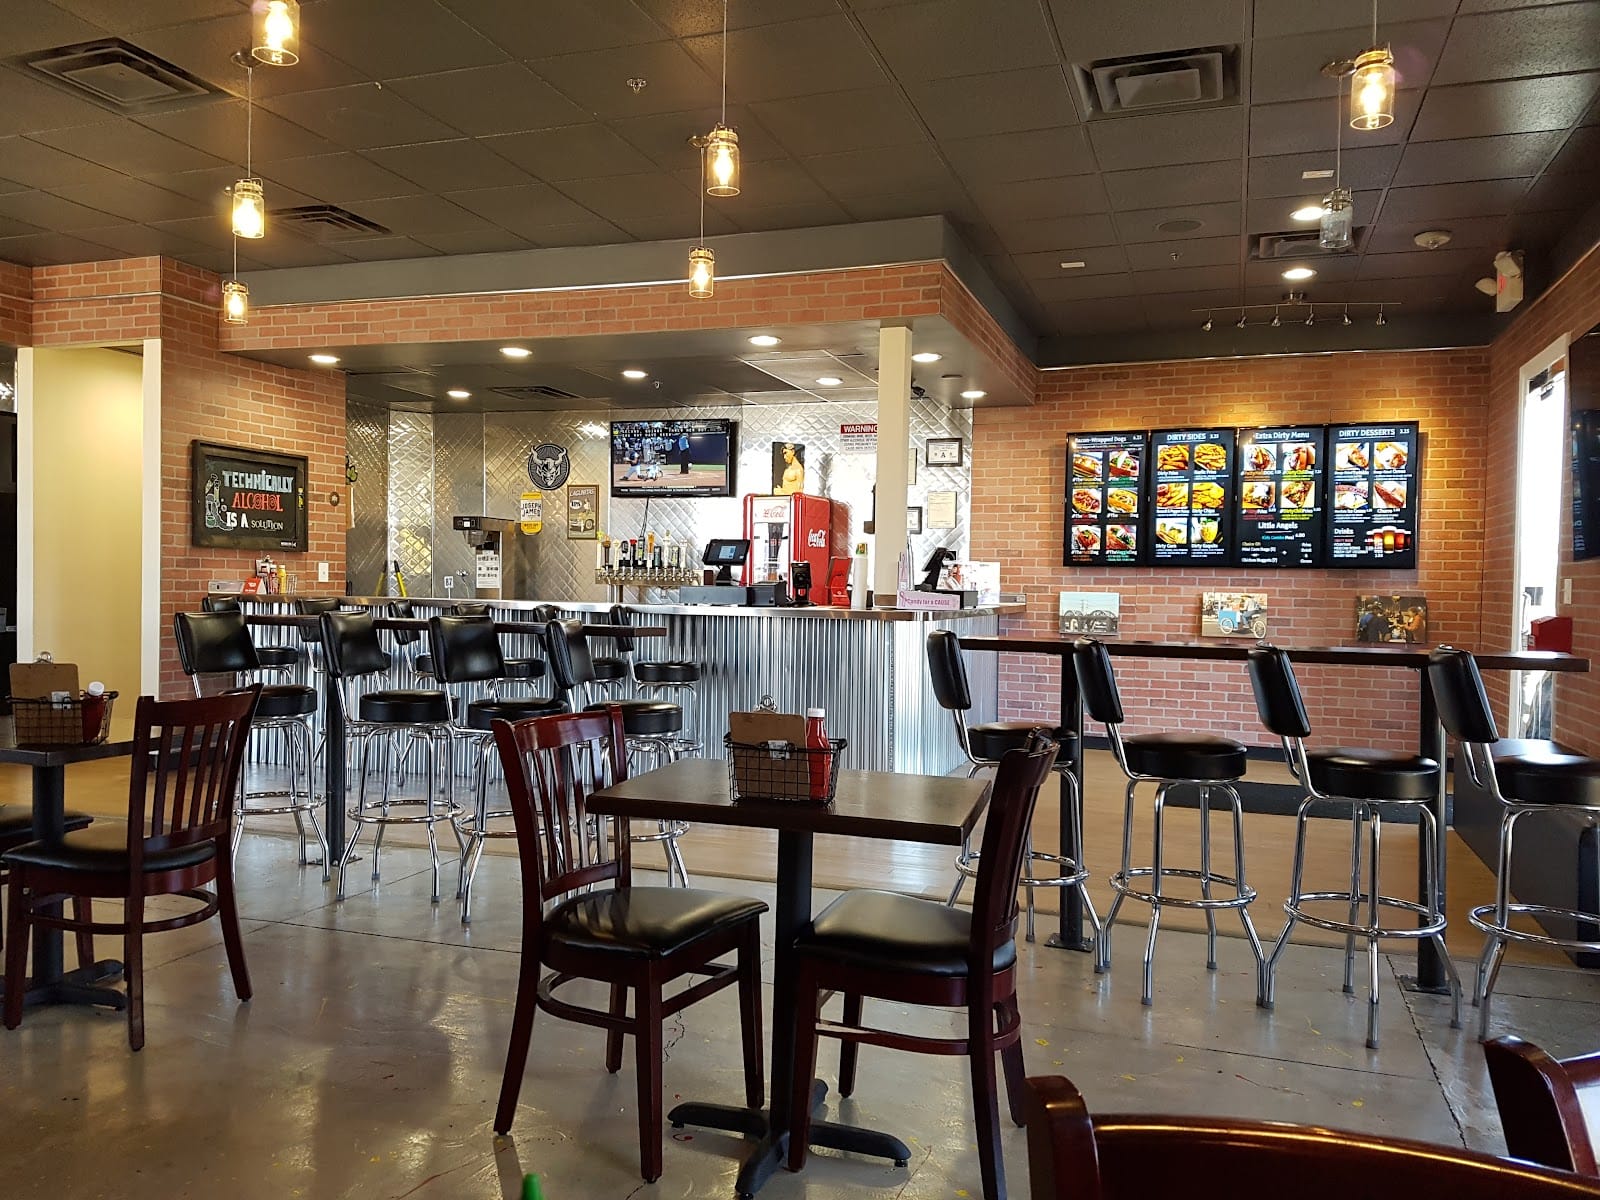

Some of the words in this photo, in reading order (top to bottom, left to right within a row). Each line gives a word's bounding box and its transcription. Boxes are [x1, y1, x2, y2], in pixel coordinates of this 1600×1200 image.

[1166, 433, 1186, 441] DIRTY
[1187, 432, 1207, 440] SIDES
[1255, 432, 1273, 440] Extra
[1273, 431, 1290, 440] Dirty
[1291, 431, 1310, 439] Menu
[1361, 428, 1396, 436] DESSERTS
[232, 492, 284, 512] ALCOHOL
[226, 511, 237, 527] IS
[240, 512, 249, 528] A
[251, 519, 284, 531] SOLUTION
[1257, 521, 1276, 529] Little
[1276, 521, 1298, 530] Angels
[1334, 527, 1354, 535] Drinks
